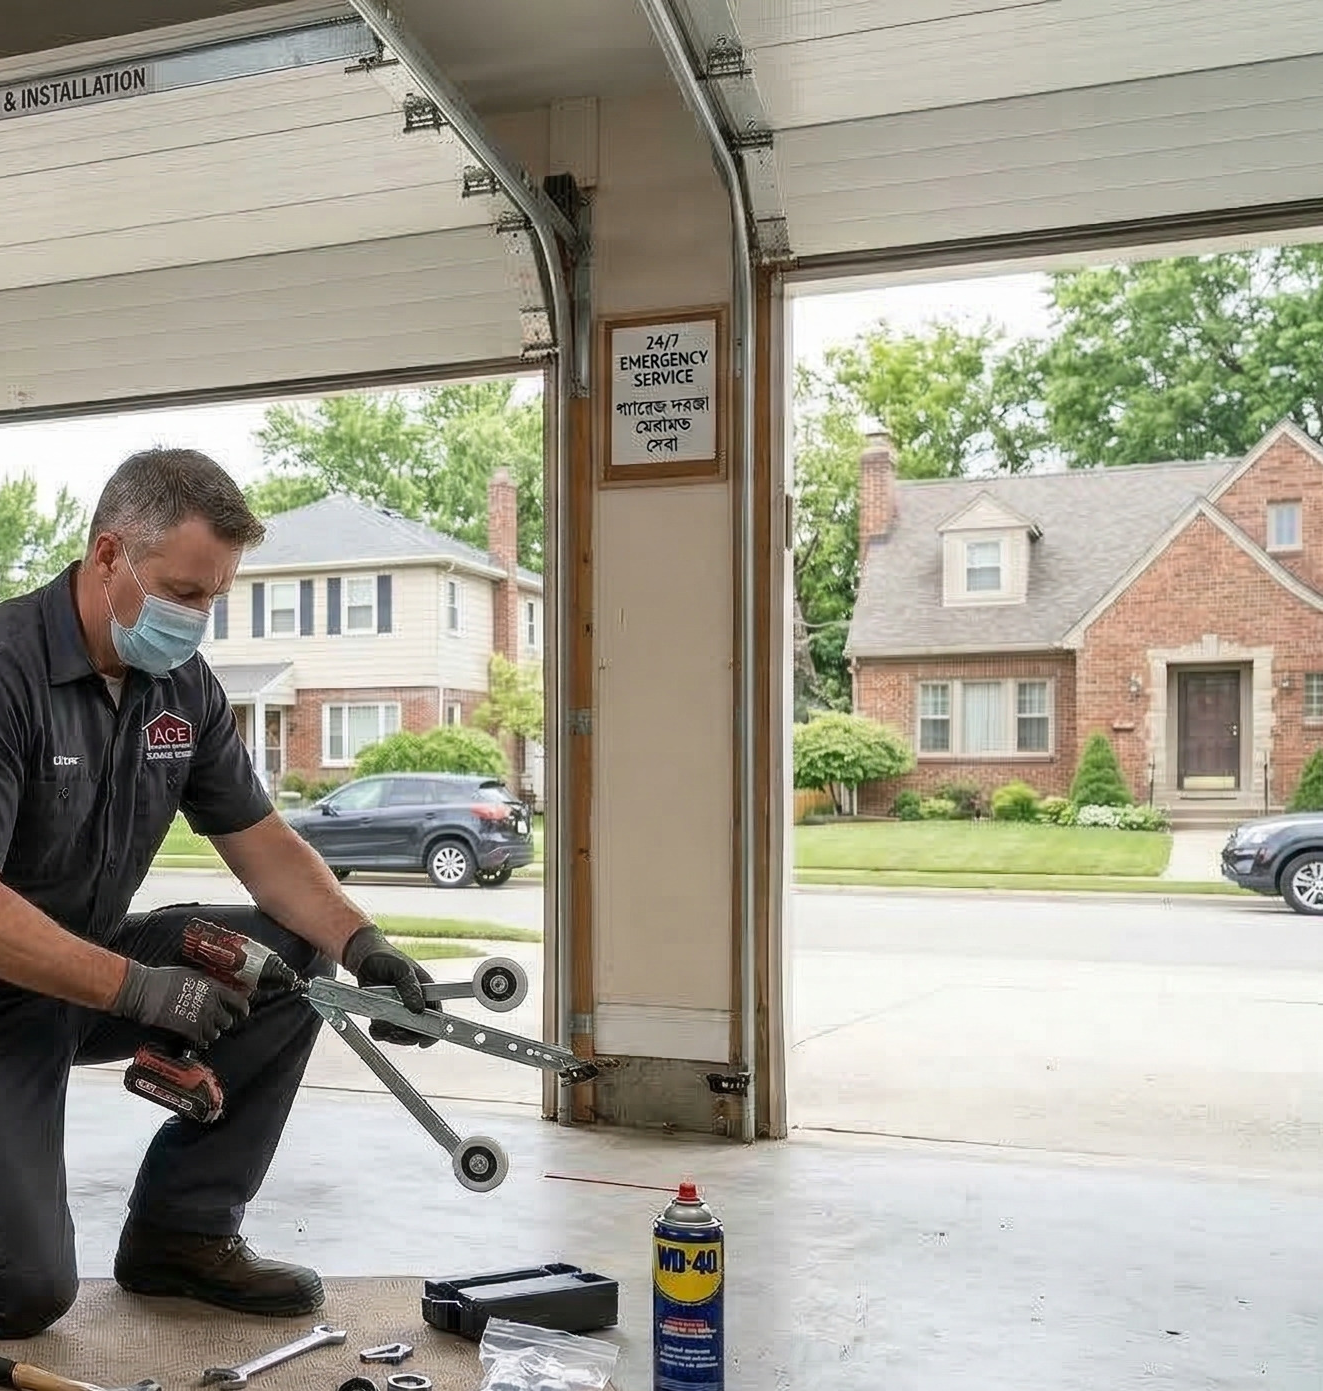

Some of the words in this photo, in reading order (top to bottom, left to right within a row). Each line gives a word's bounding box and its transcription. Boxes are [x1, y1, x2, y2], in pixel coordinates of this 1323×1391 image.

[3, 91, 17, 112] &
[21, 67, 146, 109] INSTALLATION
[646, 333, 679, 351] 24/7
[620, 350, 709, 371] EMERGENCY
[634, 368, 694, 387] SERVICE
[670, 396, 709, 414] দরজা
[646, 435, 678, 453] সেবা
[152, 727, 188, 744] ACE
[657, 1243, 718, 1275] WD-40
